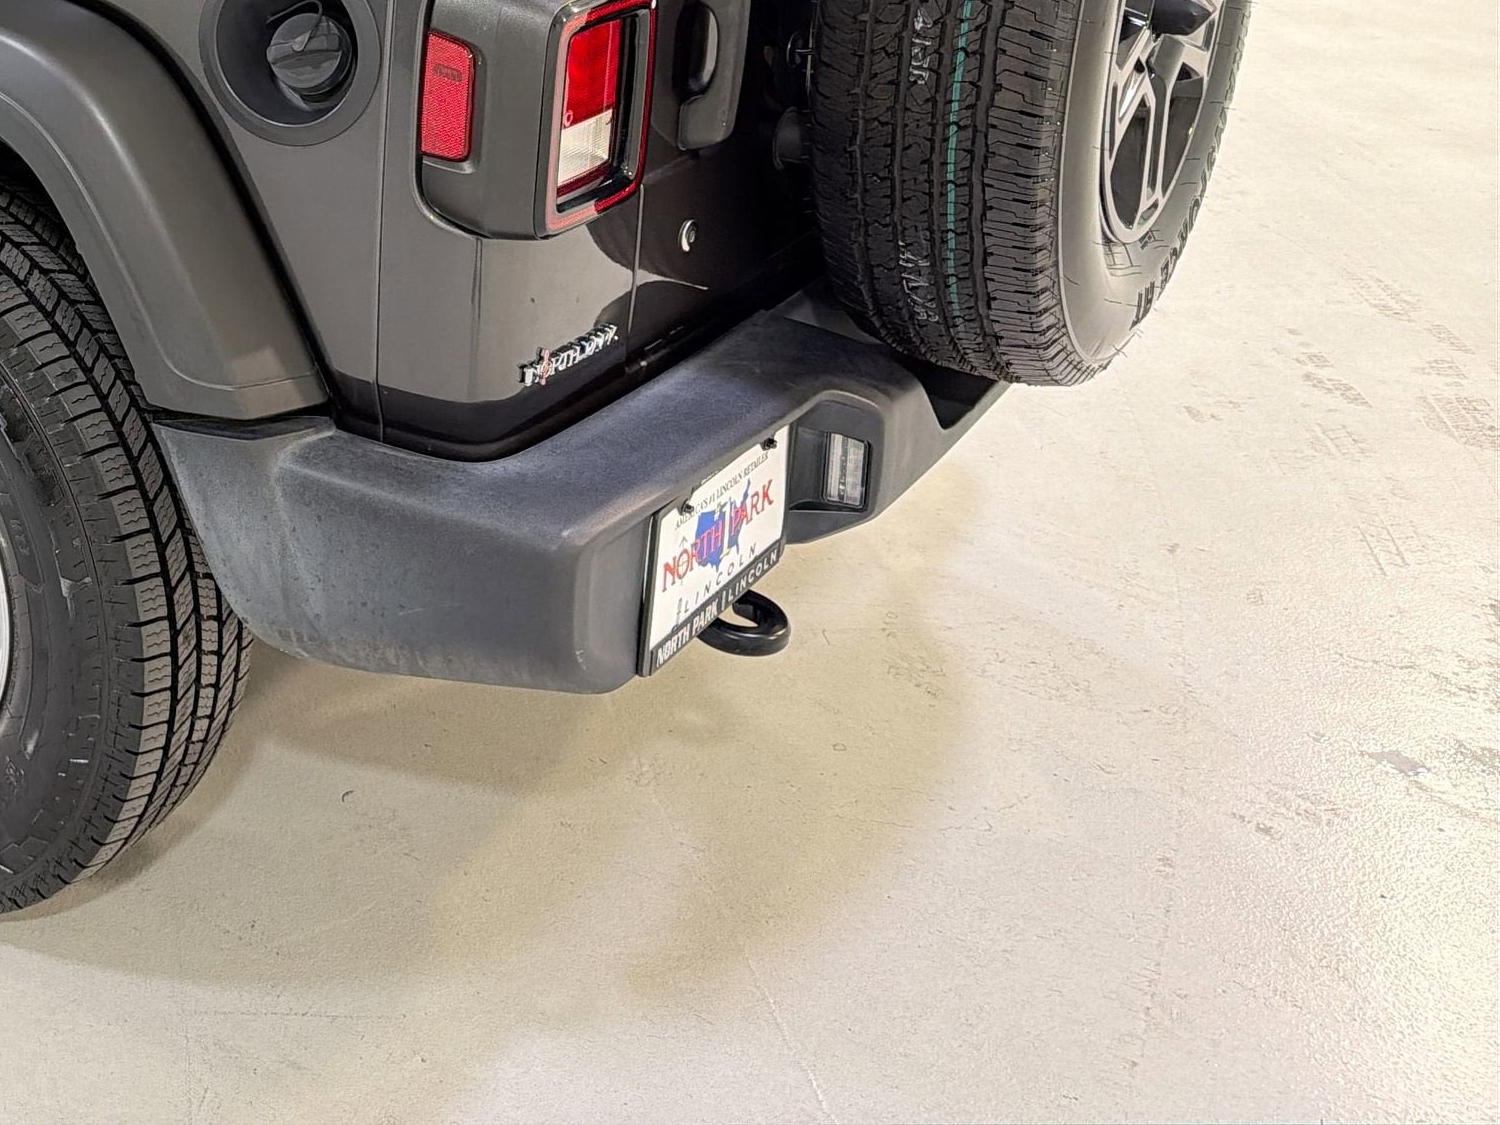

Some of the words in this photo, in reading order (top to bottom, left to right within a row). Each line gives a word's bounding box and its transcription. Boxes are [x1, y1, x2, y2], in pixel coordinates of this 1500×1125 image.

[662, 520, 725, 593] NORTH
[730, 478, 774, 536] PARK
[684, 542, 757, 614] LINCOLN
[656, 623, 692, 668] NORTH
[692, 598, 720, 637] PARK
[728, 548, 779, 603] LINCOLN
